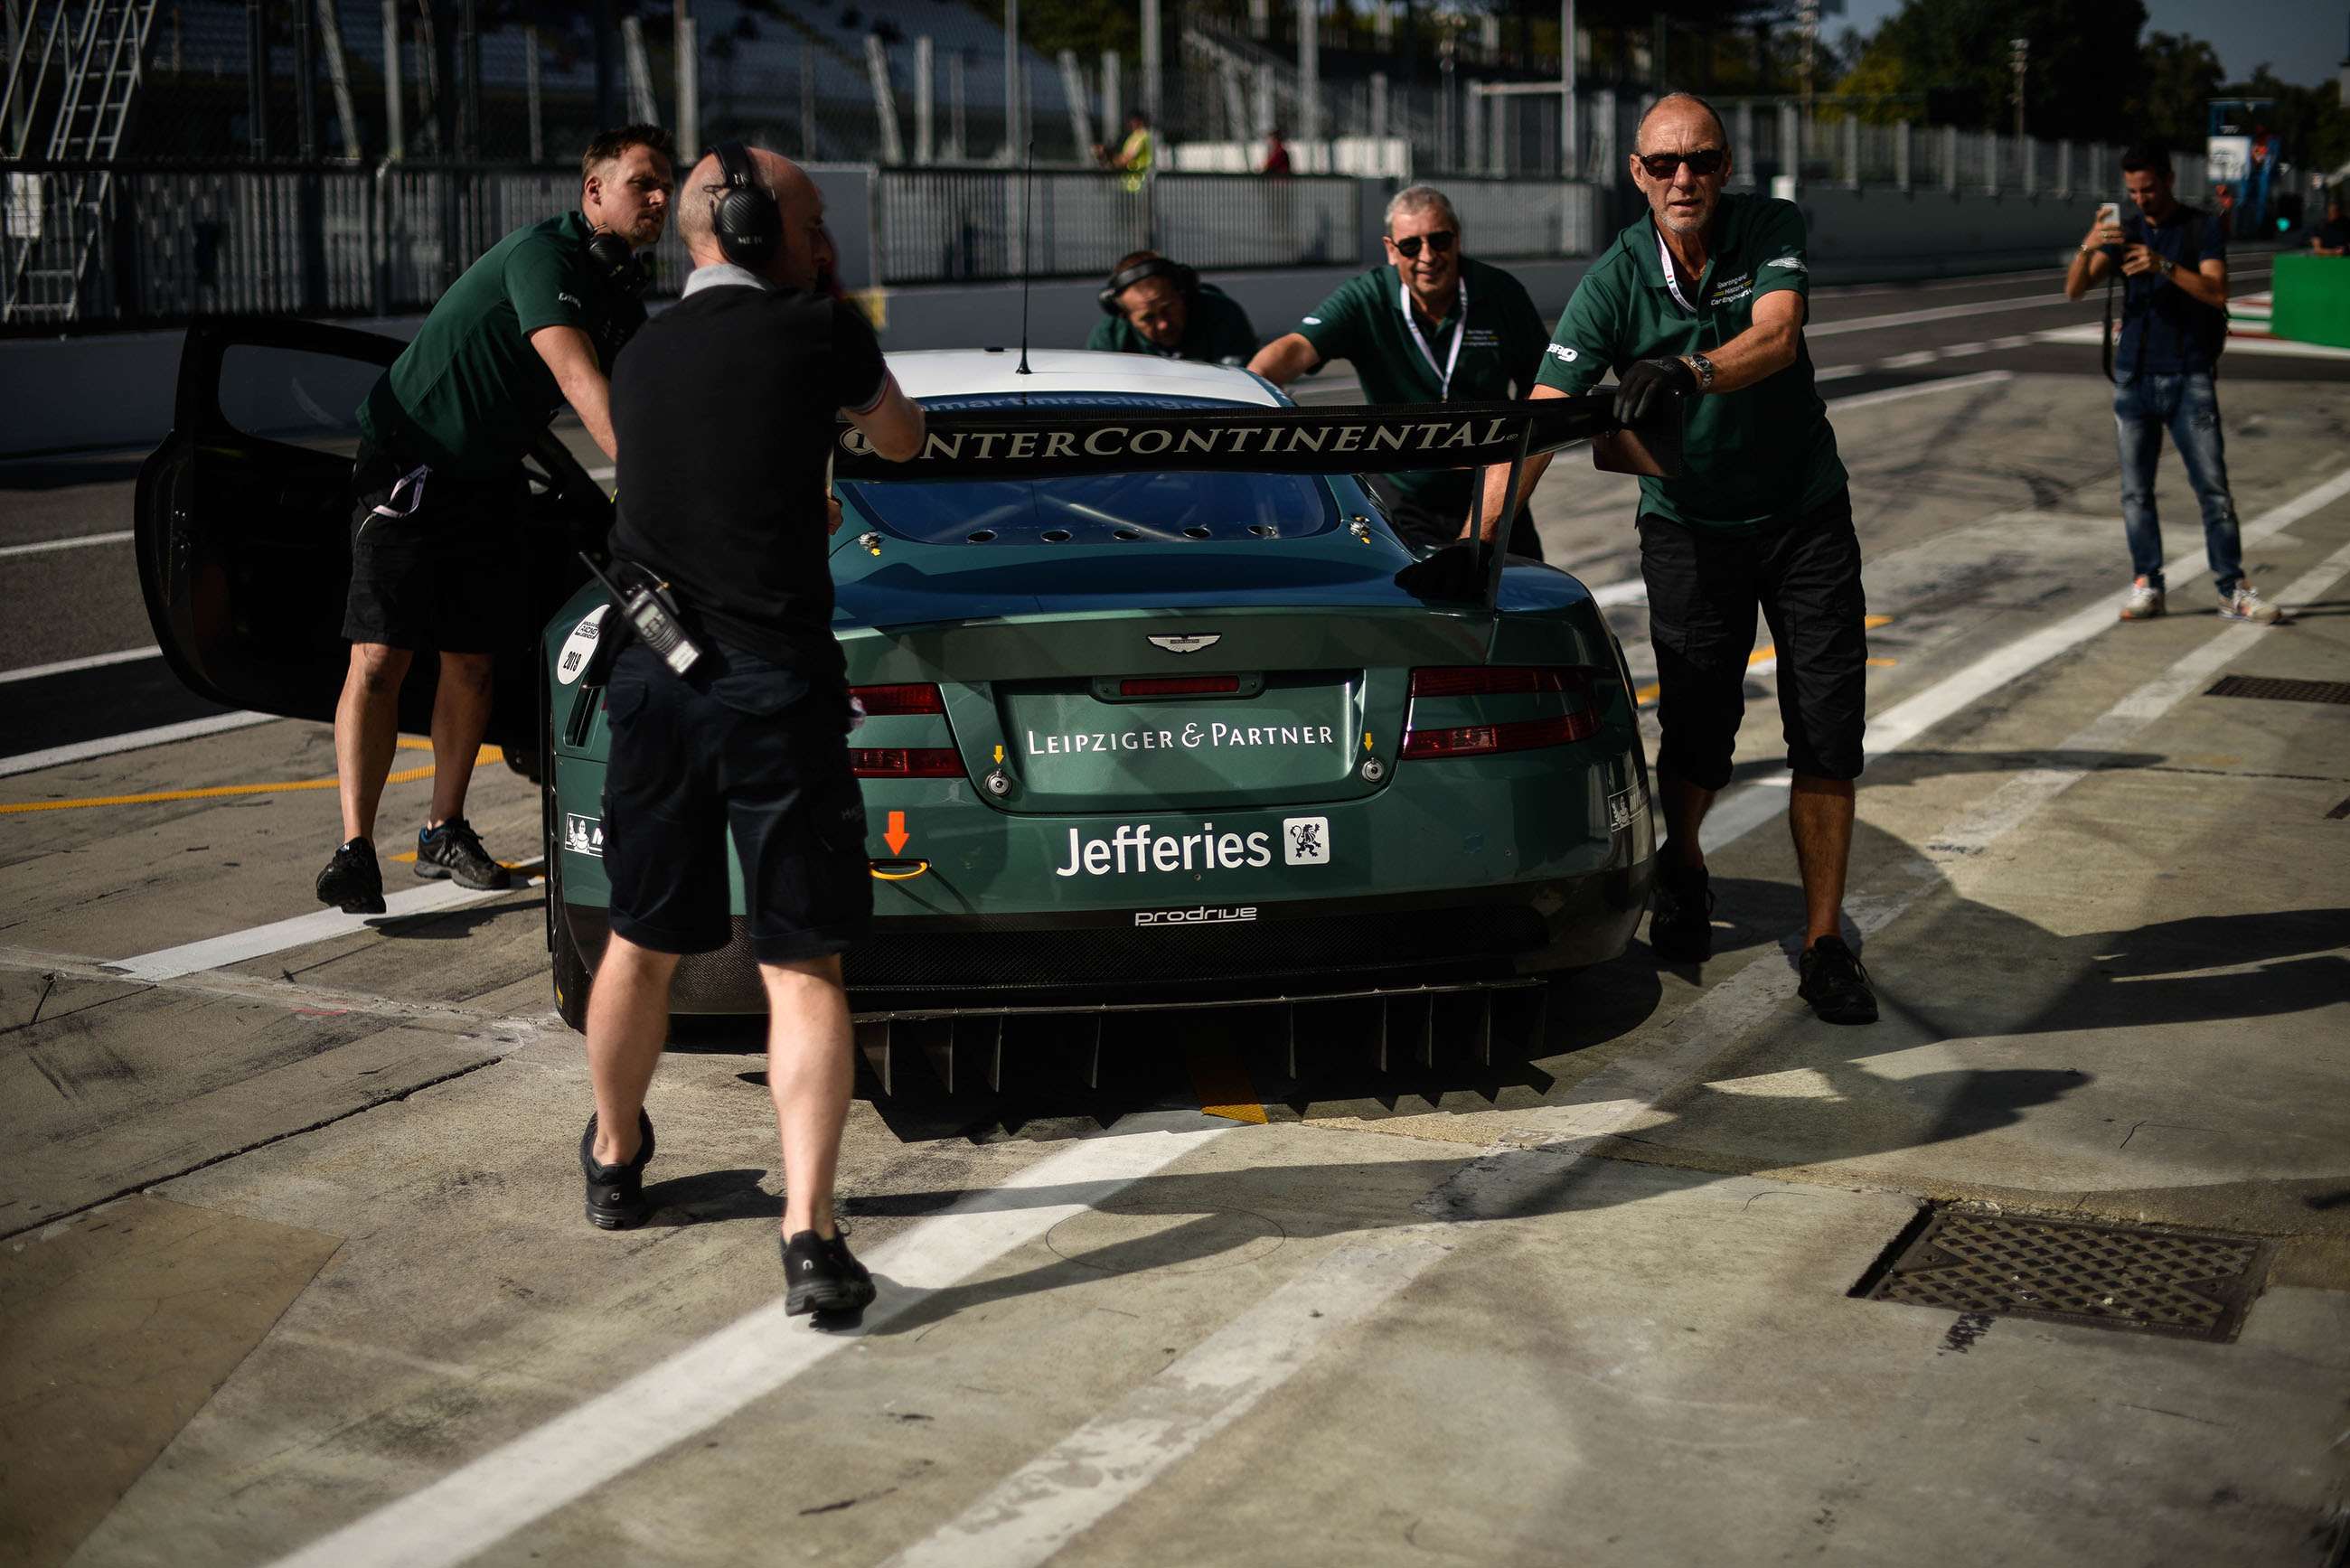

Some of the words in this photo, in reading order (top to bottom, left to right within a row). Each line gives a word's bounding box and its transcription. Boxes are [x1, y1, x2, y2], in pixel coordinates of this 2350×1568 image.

[917, 418, 1507, 460] NTERCONTINENTAL
[562, 651, 582, 672] 2019
[1028, 729, 1173, 756] LEIPZIGER
[1180, 722, 1205, 747] &
[1211, 722, 1334, 747] PARTNER
[1056, 822, 1271, 877] Jefferies
[1134, 906, 1257, 926] prodrive
